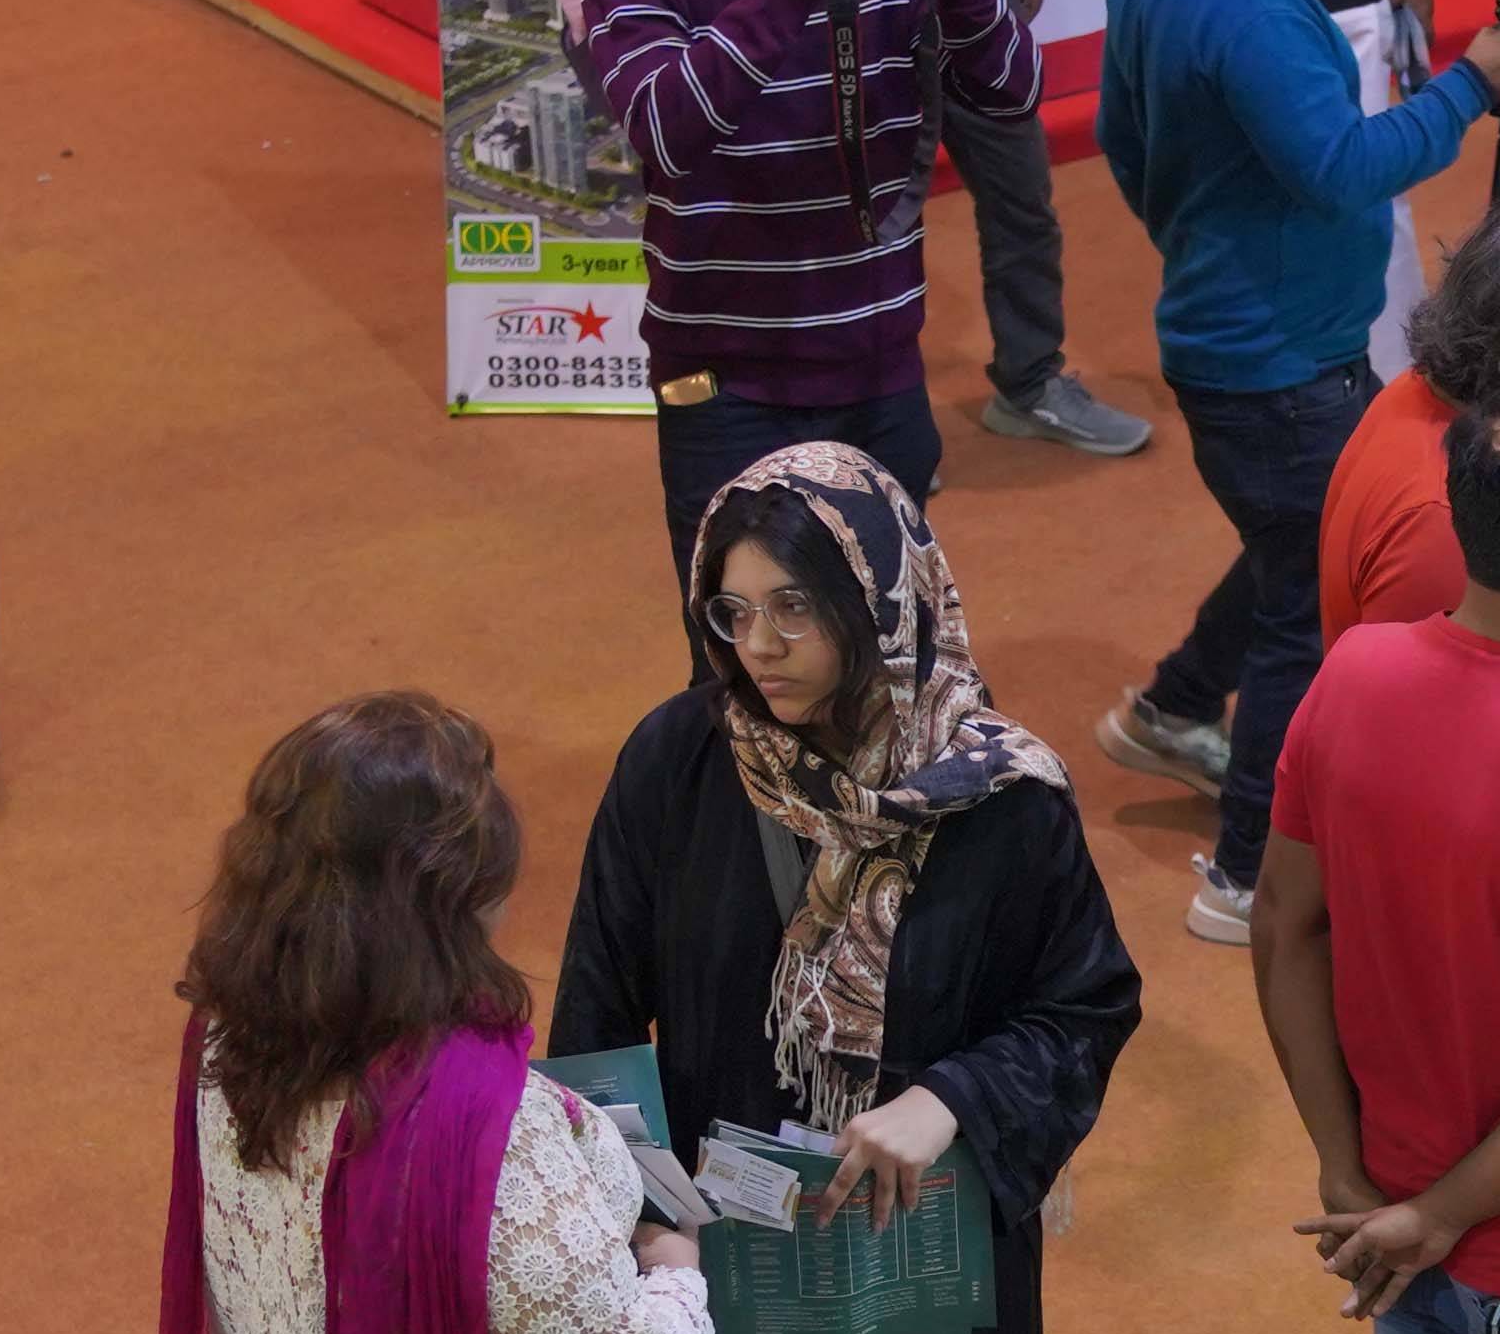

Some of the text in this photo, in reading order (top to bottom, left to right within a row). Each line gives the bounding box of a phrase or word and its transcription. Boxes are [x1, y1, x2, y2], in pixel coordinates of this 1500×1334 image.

[836, 26, 855, 64] EOS
[839, 64, 857, 97] 5D
[461, 255, 535, 268] APPROVED
[561, 254, 629, 276] 3-year
[496, 316, 568, 337] STAR
[488, 355, 650, 371] 0300-8435
[488, 373, 650, 389] 0300-8435
